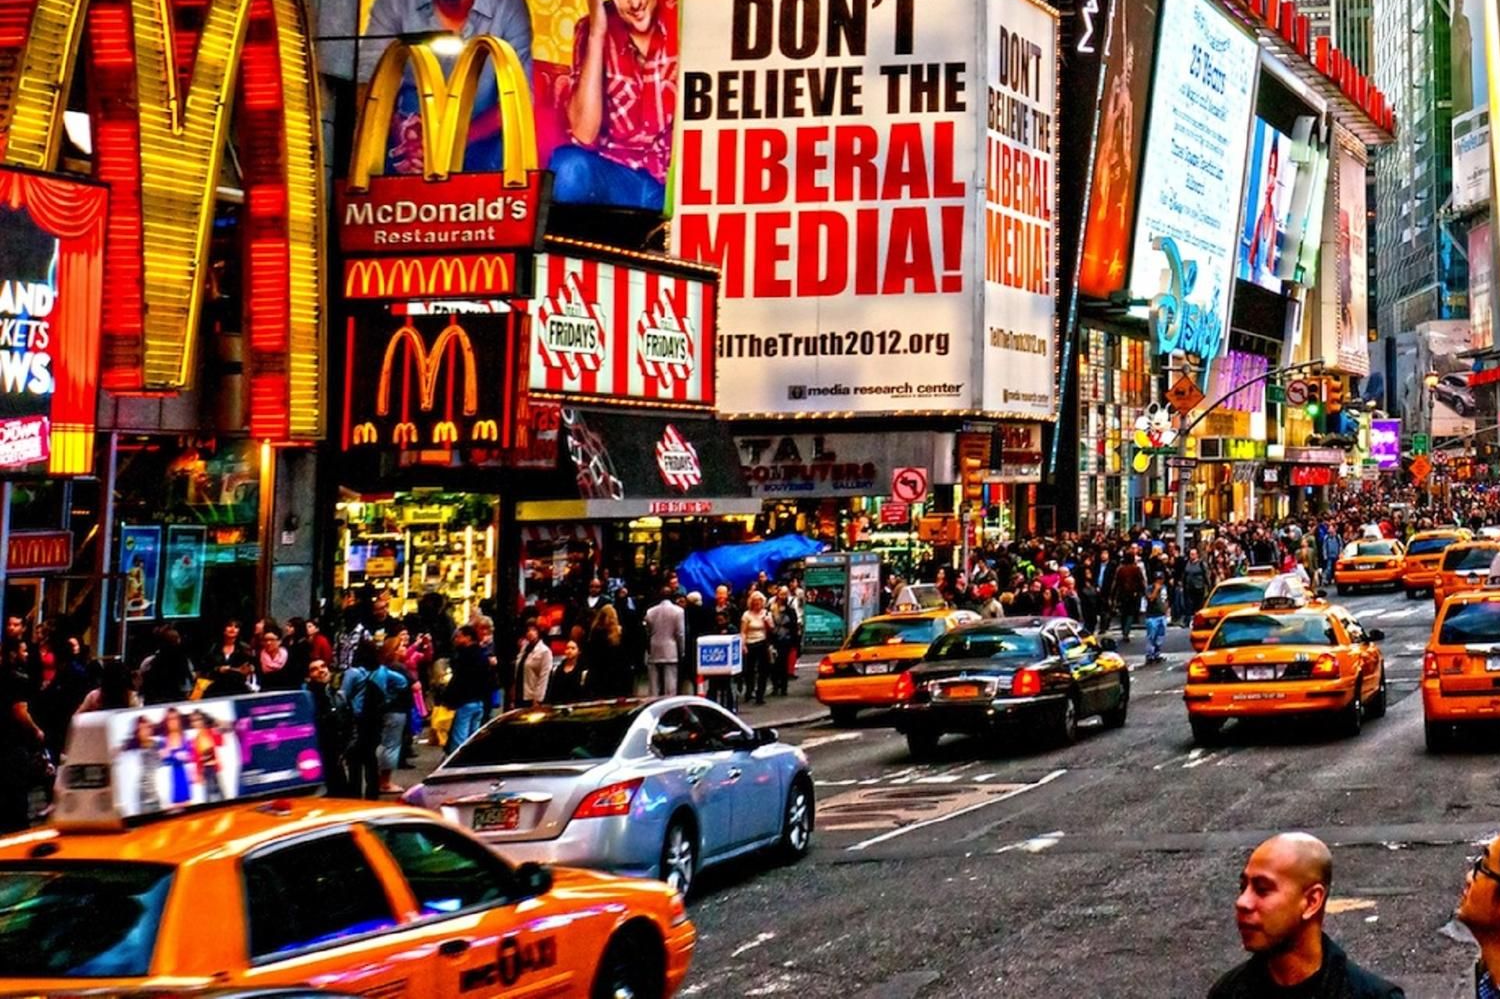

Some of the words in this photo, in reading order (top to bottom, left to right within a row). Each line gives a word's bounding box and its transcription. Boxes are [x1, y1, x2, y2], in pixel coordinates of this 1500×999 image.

[683, 65, 863, 121] BELIEVE
[881, 62, 966, 115] THE
[1000, 24, 1042, 103] DON'T
[988, 85, 1028, 146] BELIEVE
[1032, 108, 1051, 154] THE
[681, 121, 966, 206] LIBERAL
[986, 136, 1050, 221] LIBERAL
[345, 197, 527, 225] McDonald's
[374, 226, 496, 244] Restaurant
[677, 205, 965, 299] MEDIA!
[986, 208, 1051, 296] MEDIA!
[550, 320, 596, 349] FRiDAYS
[646, 337, 686, 360] FRiDAYS
[808, 382, 850, 396] media
[854, 382, 913, 395] research
[916, 382, 964, 395] center
